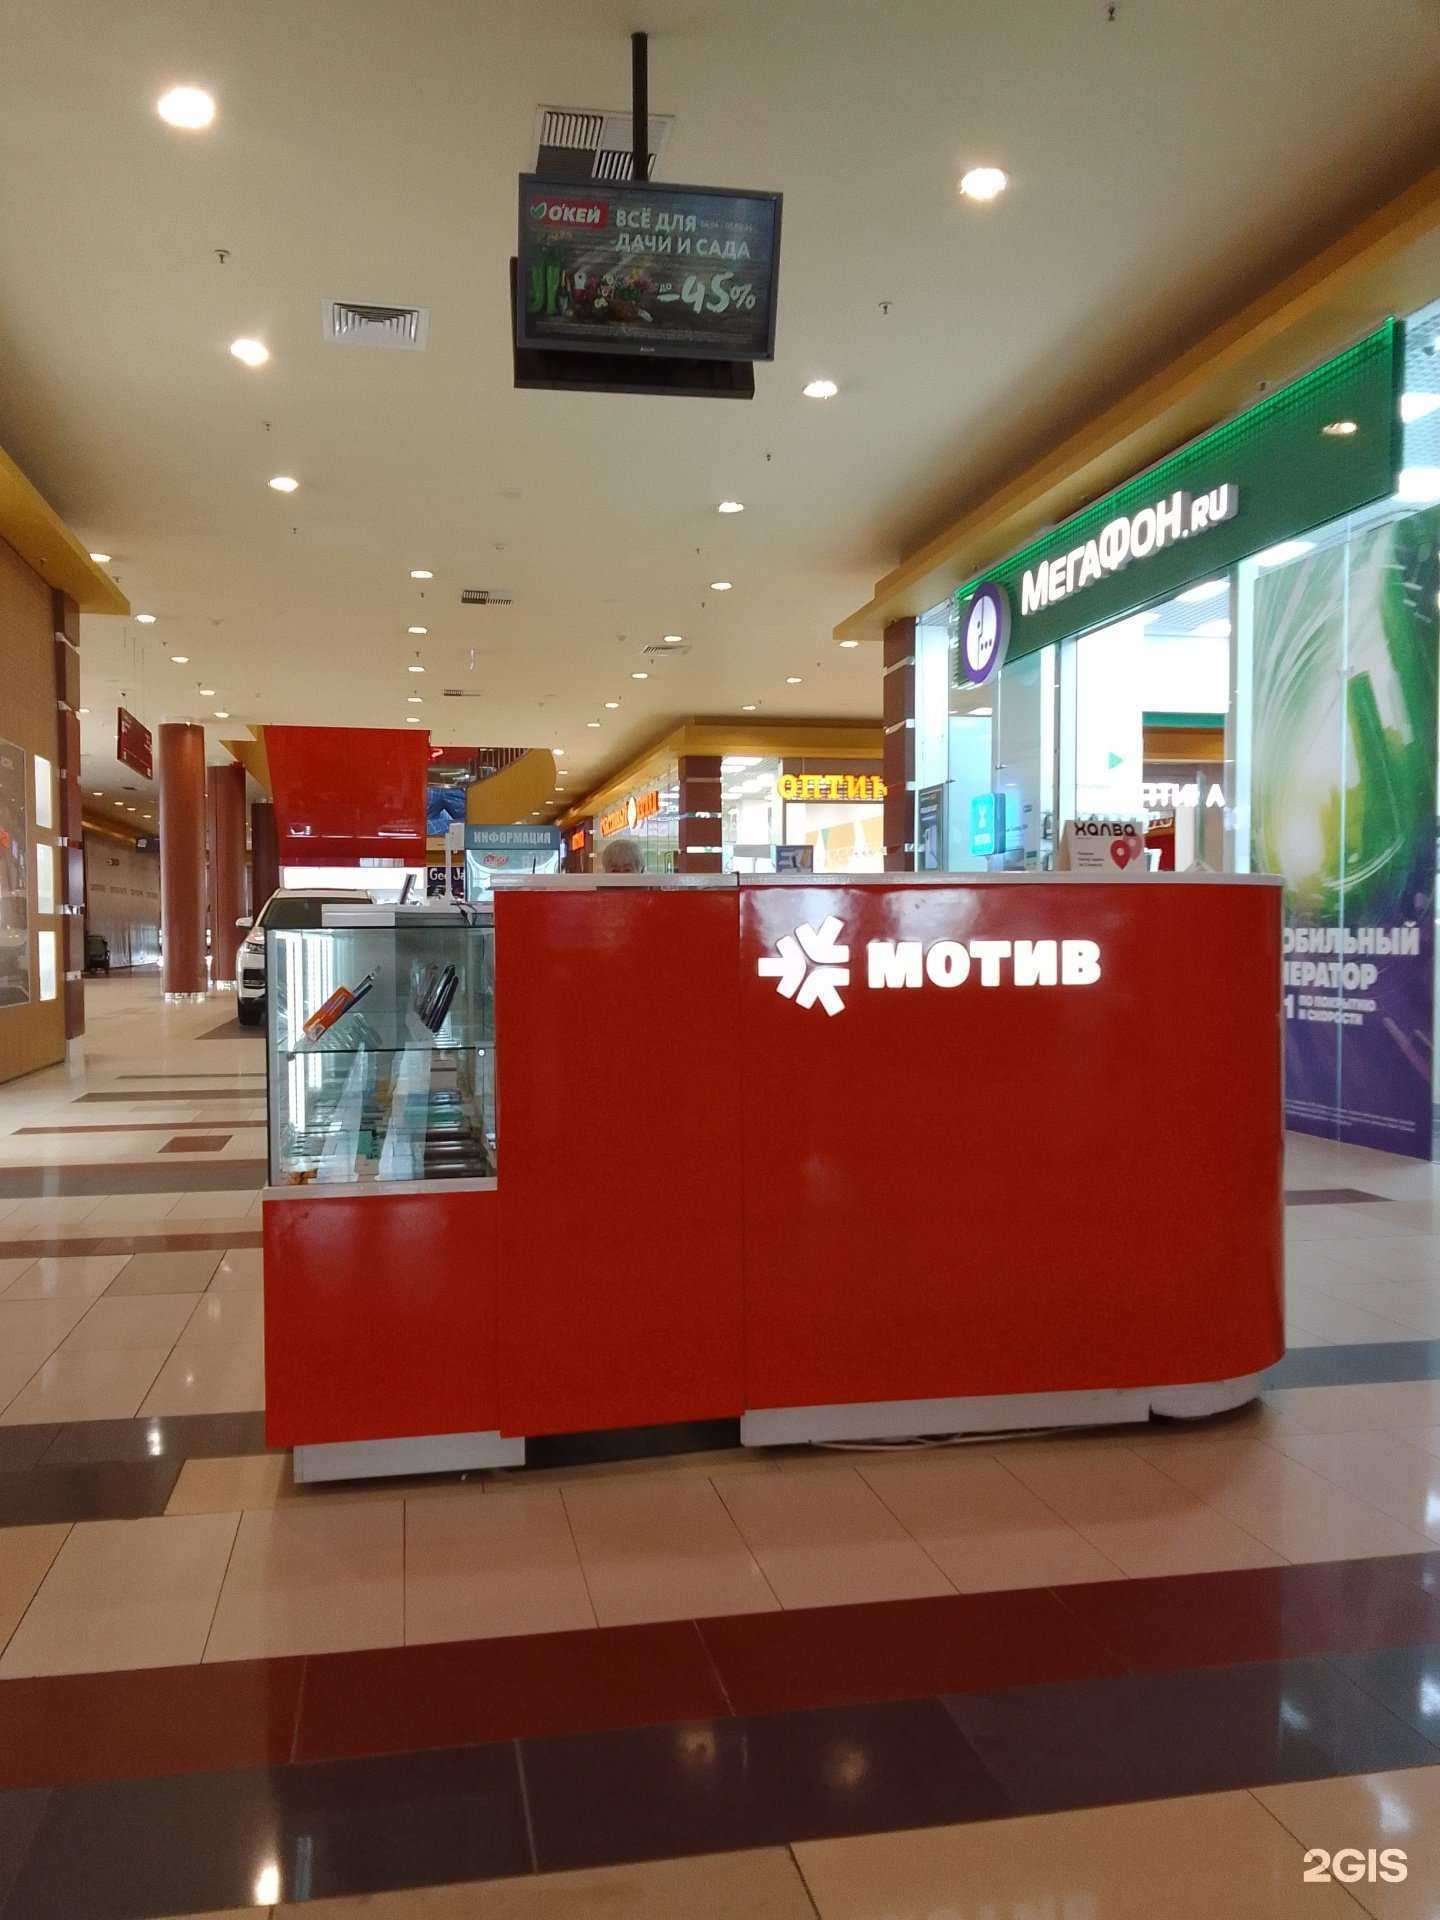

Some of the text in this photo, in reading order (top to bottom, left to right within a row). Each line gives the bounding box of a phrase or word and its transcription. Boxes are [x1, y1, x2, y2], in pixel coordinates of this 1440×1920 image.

[615, 208, 650, 230] ВСЁ
[655, 214, 697, 233] ДЛЯ
[614, 233, 752, 260] ДАЧИ И САДА
[473, 830, 552, 845] ИНФОРМАЦИЯ
[867, 940, 1102, 989] МОТИВ
